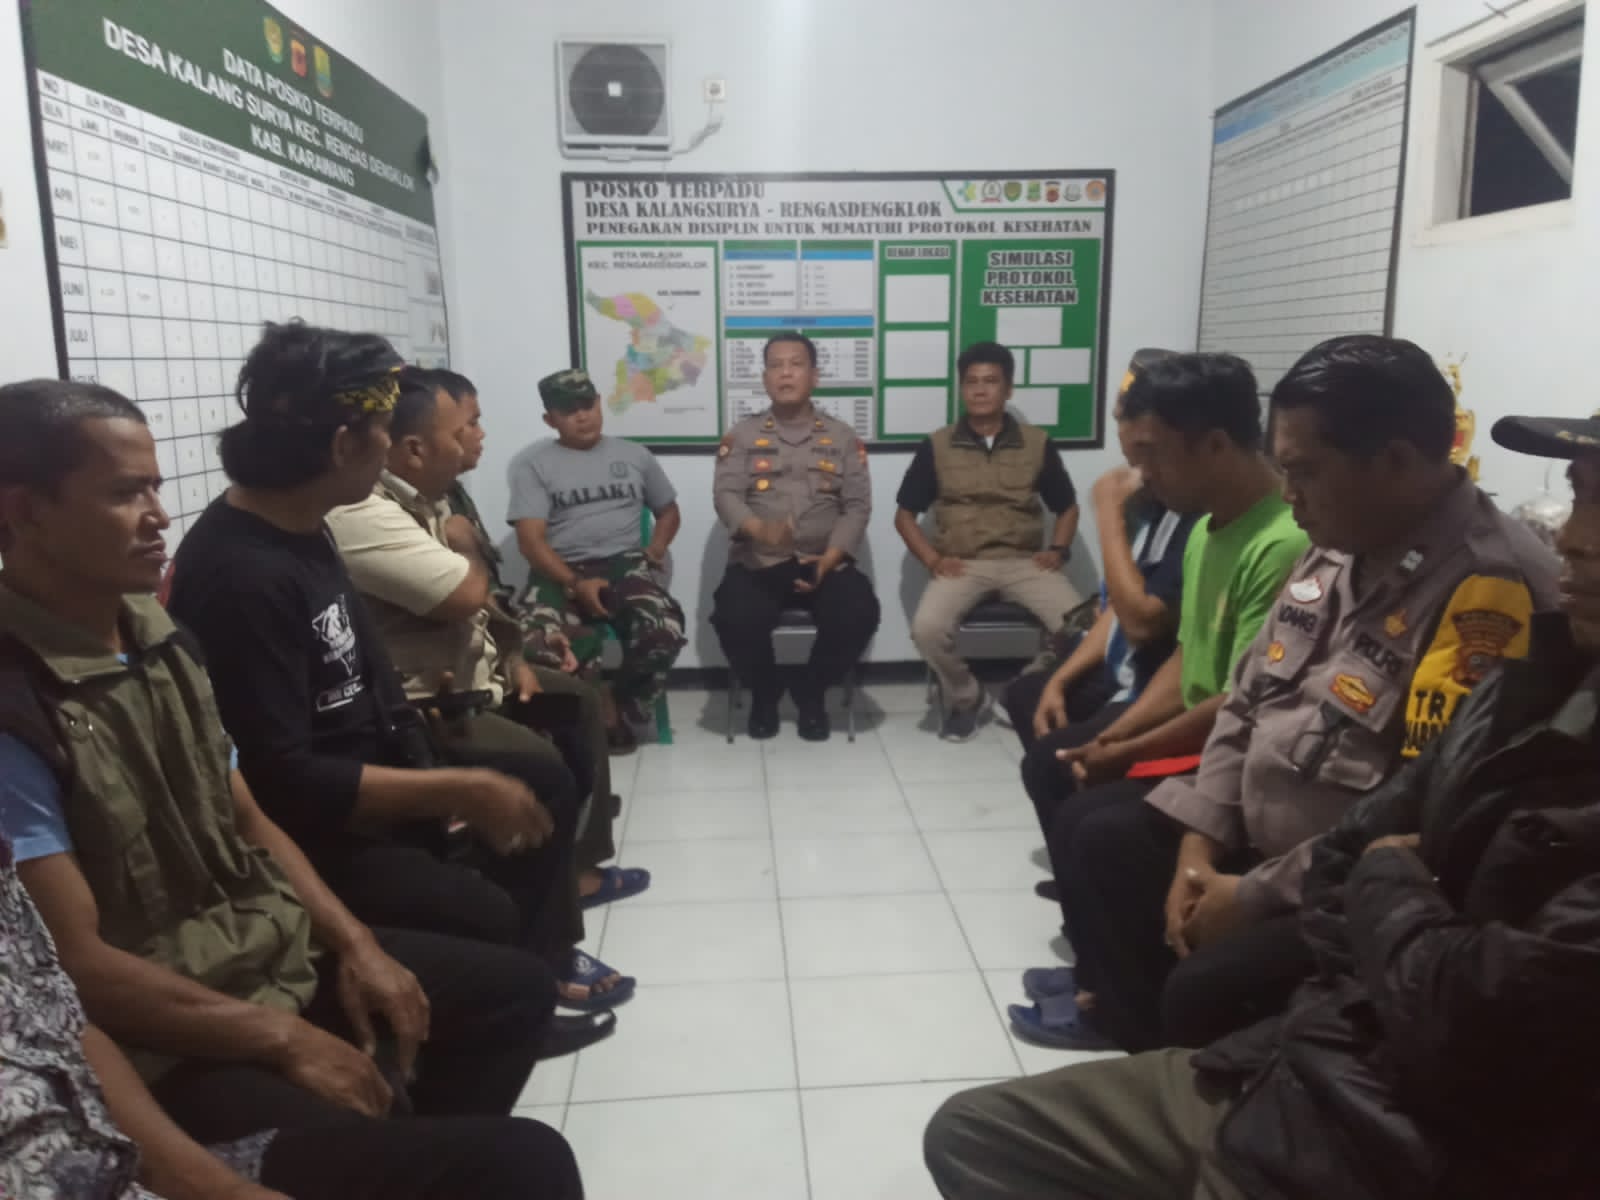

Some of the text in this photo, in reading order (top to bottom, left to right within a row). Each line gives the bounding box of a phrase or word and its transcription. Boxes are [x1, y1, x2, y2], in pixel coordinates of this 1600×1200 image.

[103, 16, 167, 74] DESA
[168, 51, 243, 109] KALANG
[246, 91, 292, 133] SURYA
[325, 131, 368, 169] RENGAS
[223, 47, 364, 144] DATA POSKO TERPADU
[251, 123, 287, 158] KAB.
[287, 141, 354, 187] KARAWANG
[584, 180, 765, 198] POSKO TERPADU
[585, 201, 630, 217] DESA
[636, 200, 760, 217] KALANGSURYA
[780, 200, 942, 217] RENGASDENGKLOK
[586, 219, 1092, 234] PENEGAKAN DISIPLIN UNTUK MEMATUHI PROTOKOL KESEHATAN
[990, 251, 1072, 265] SIMULASI
[986, 270, 1074, 285] PROTOKOL
[981, 289, 1078, 304] KESEHATAN
